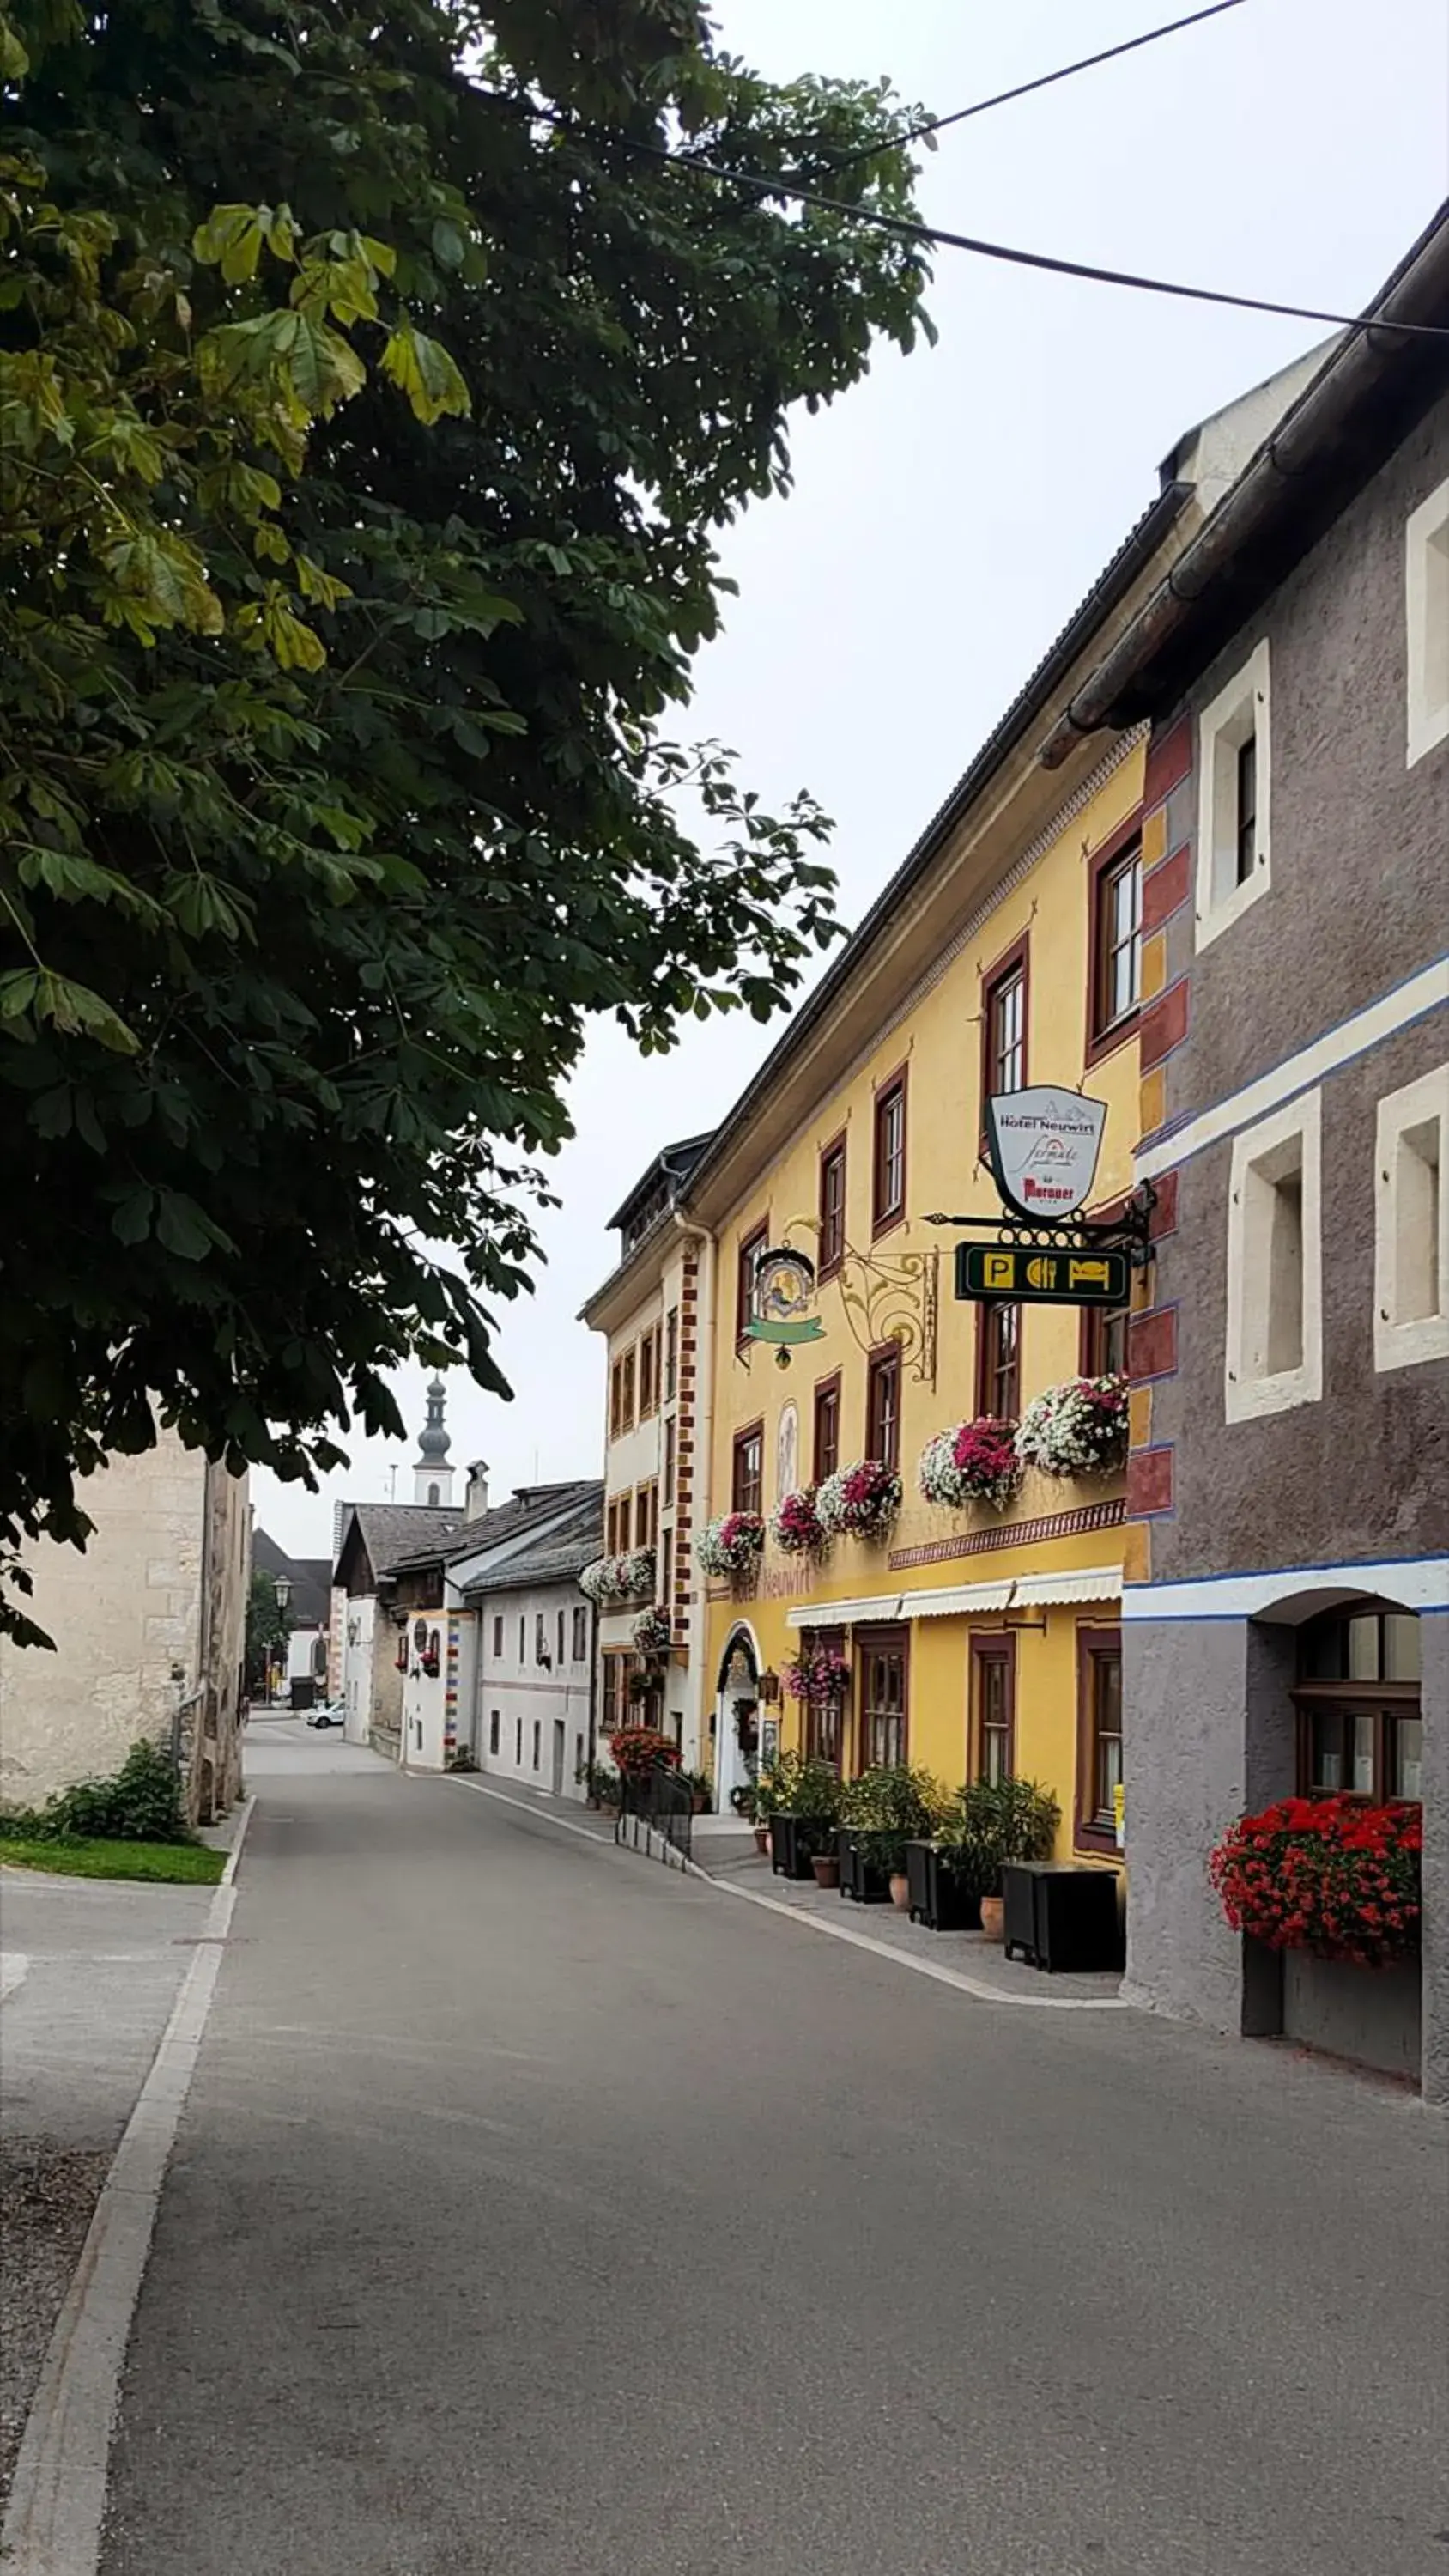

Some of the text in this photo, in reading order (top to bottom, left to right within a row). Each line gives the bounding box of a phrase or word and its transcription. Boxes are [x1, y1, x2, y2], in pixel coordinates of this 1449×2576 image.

[1000, 1114, 1094, 1133] Hotel Neuwirt
[991, 1259, 1009, 1284] P
